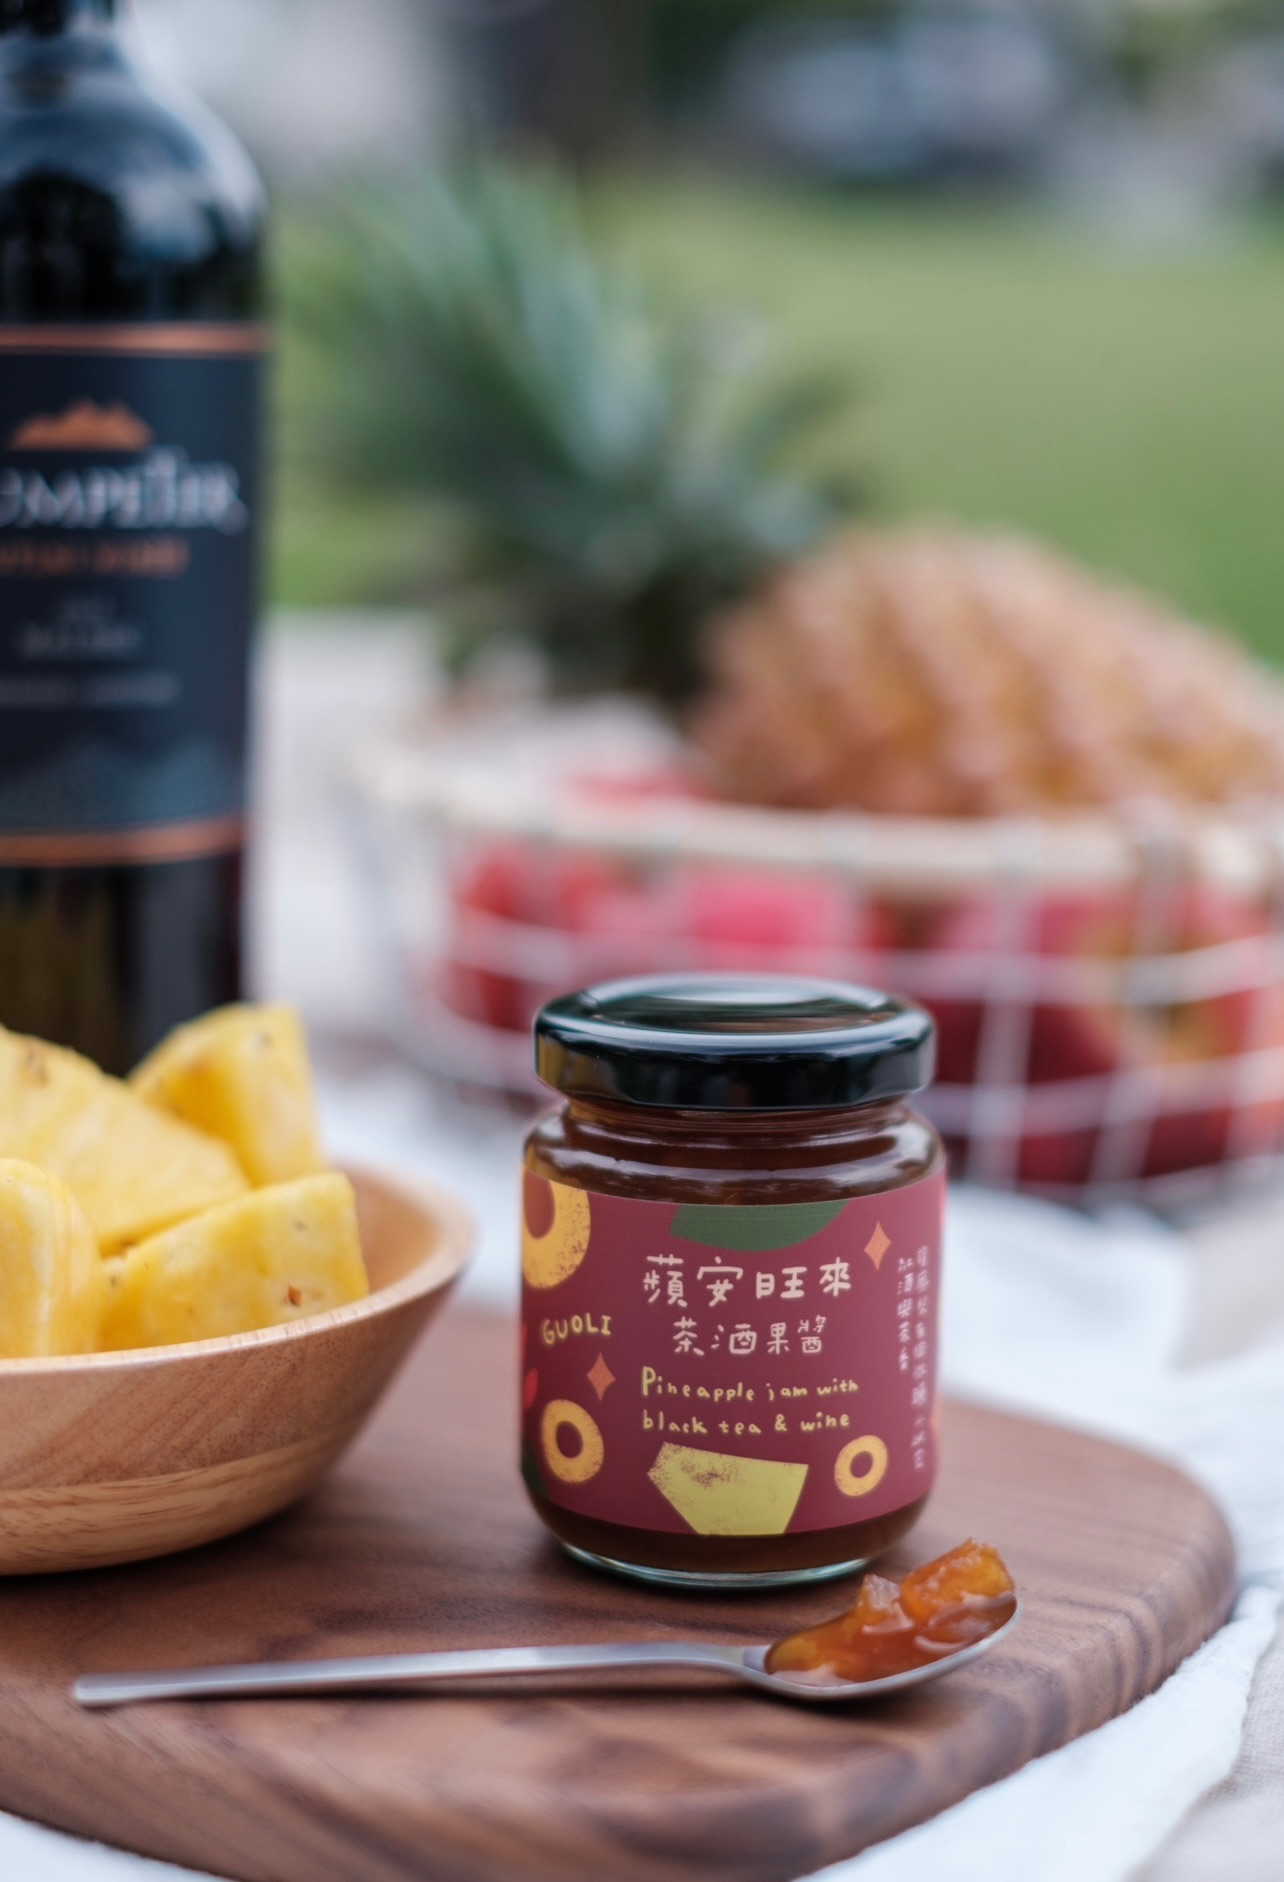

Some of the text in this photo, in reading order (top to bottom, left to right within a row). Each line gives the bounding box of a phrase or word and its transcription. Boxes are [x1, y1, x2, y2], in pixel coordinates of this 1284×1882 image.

[643, 1254, 851, 1307] 蘋安旺來
[542, 1313, 612, 1345] GUOLI
[673, 1315, 826, 1355] 茶酒果醬
[642, 1366, 858, 1401] Pineapple jam with
[643, 1409, 850, 1434] black tea & wine
